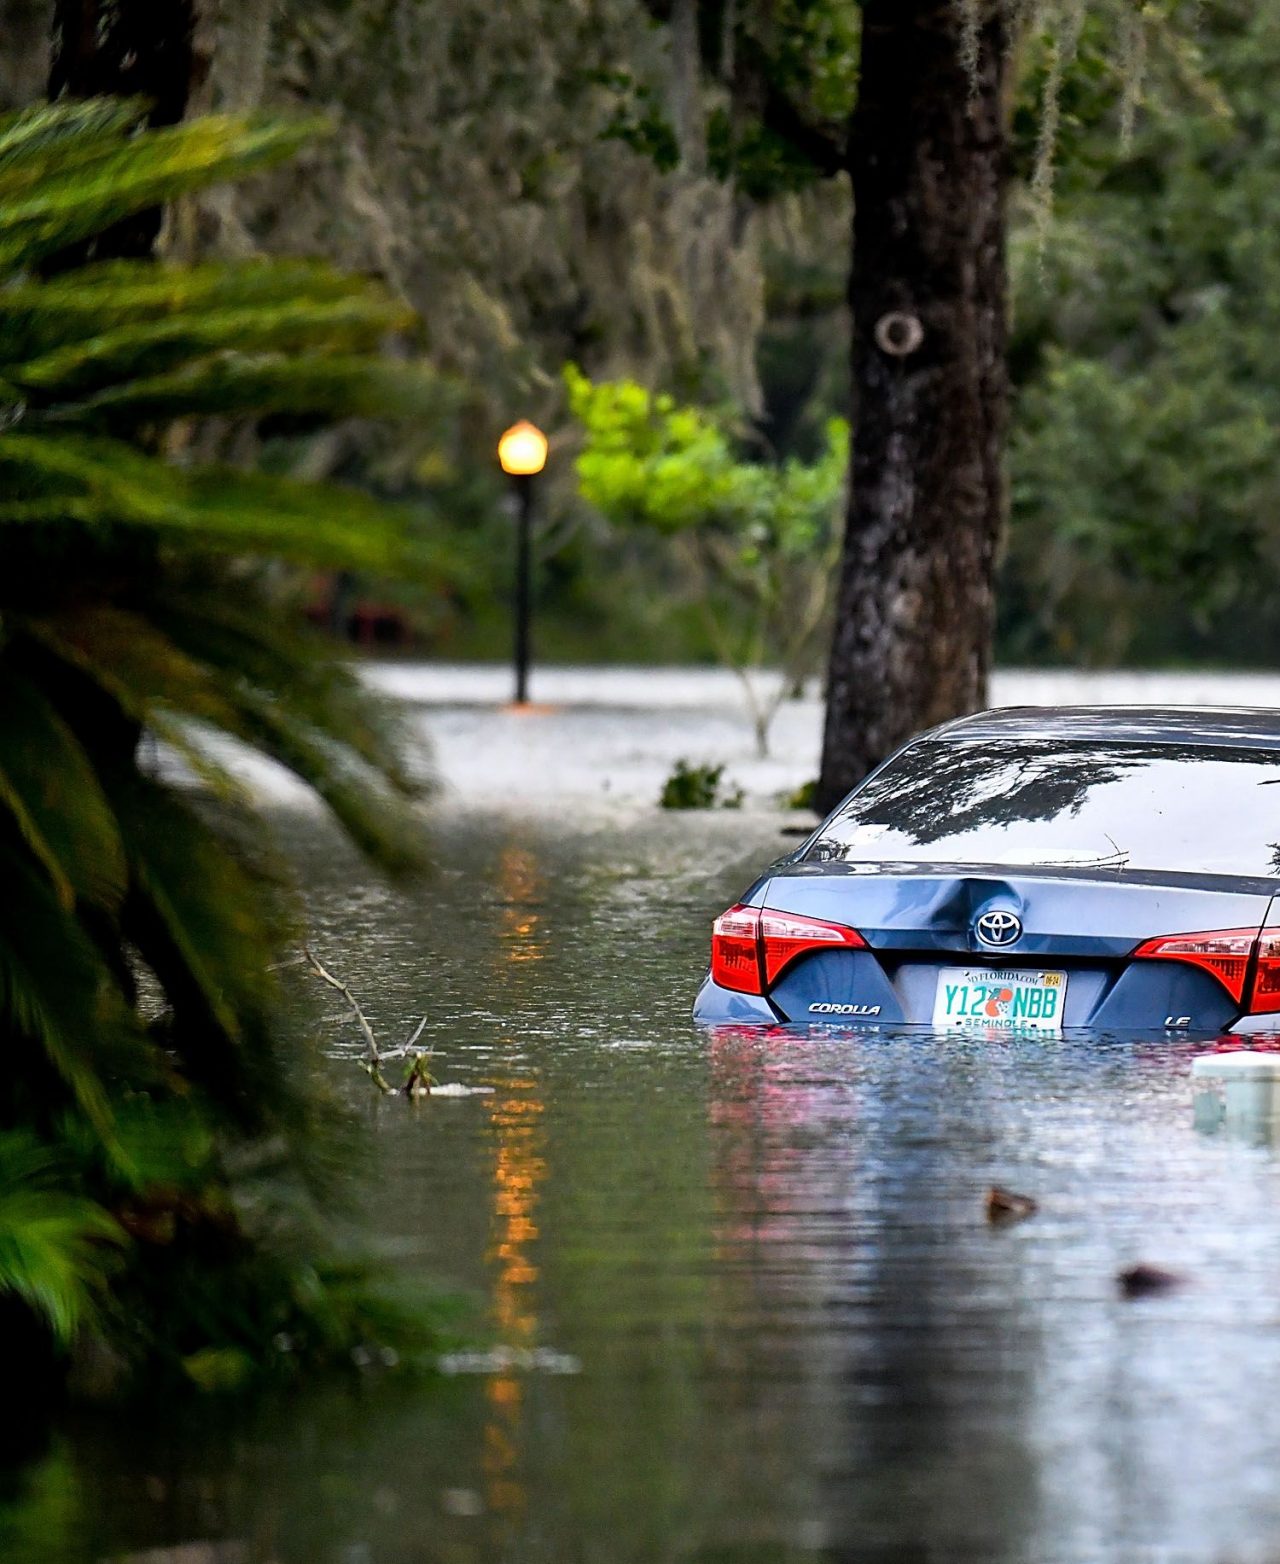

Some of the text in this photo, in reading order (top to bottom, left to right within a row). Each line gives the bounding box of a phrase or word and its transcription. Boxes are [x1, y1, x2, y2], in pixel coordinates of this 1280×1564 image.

[945, 985, 1057, 1018] Y12 NBB
[808, 1002, 881, 1016] COROLLA
[965, 1018, 1028, 1028] SEMINOLE
[1164, 1016, 1191, 1026] LE
